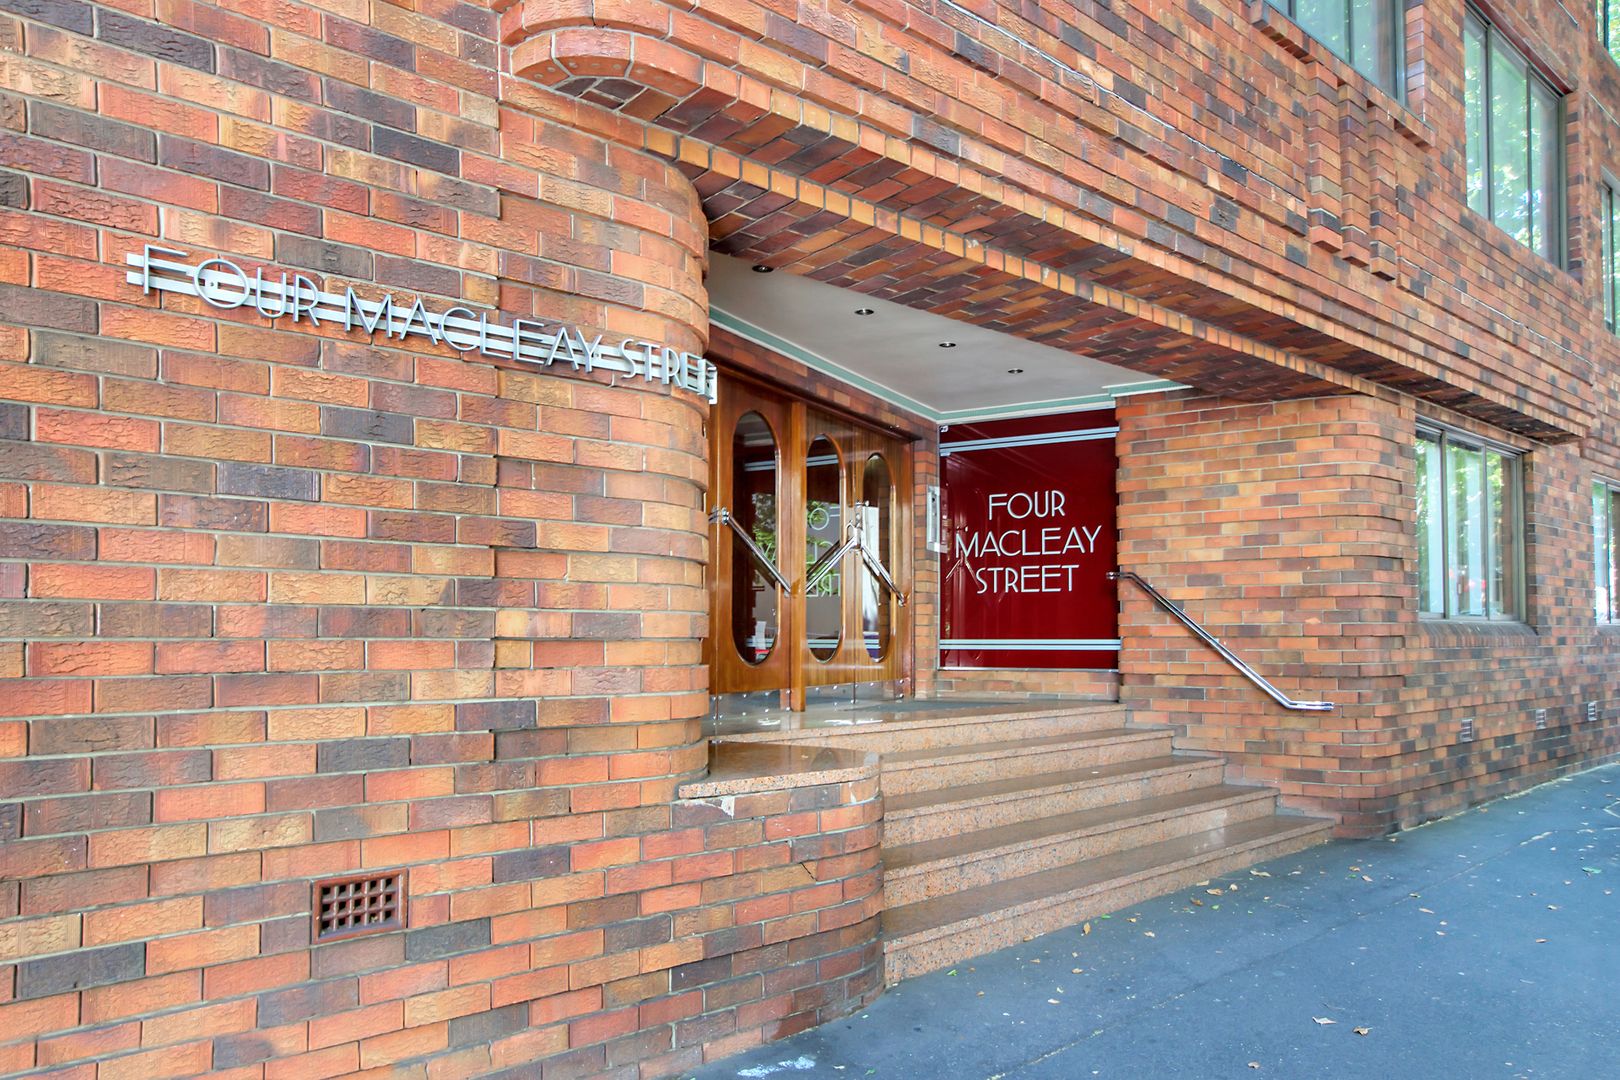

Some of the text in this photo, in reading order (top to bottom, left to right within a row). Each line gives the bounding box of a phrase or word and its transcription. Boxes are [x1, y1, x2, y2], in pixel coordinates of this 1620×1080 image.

[143, 243, 718, 405] FOUR MACLEAY STREE
[988, 489, 1066, 521] FOUR
[955, 525, 1102, 558] MACLEAY
[975, 564, 1080, 594] STREET
